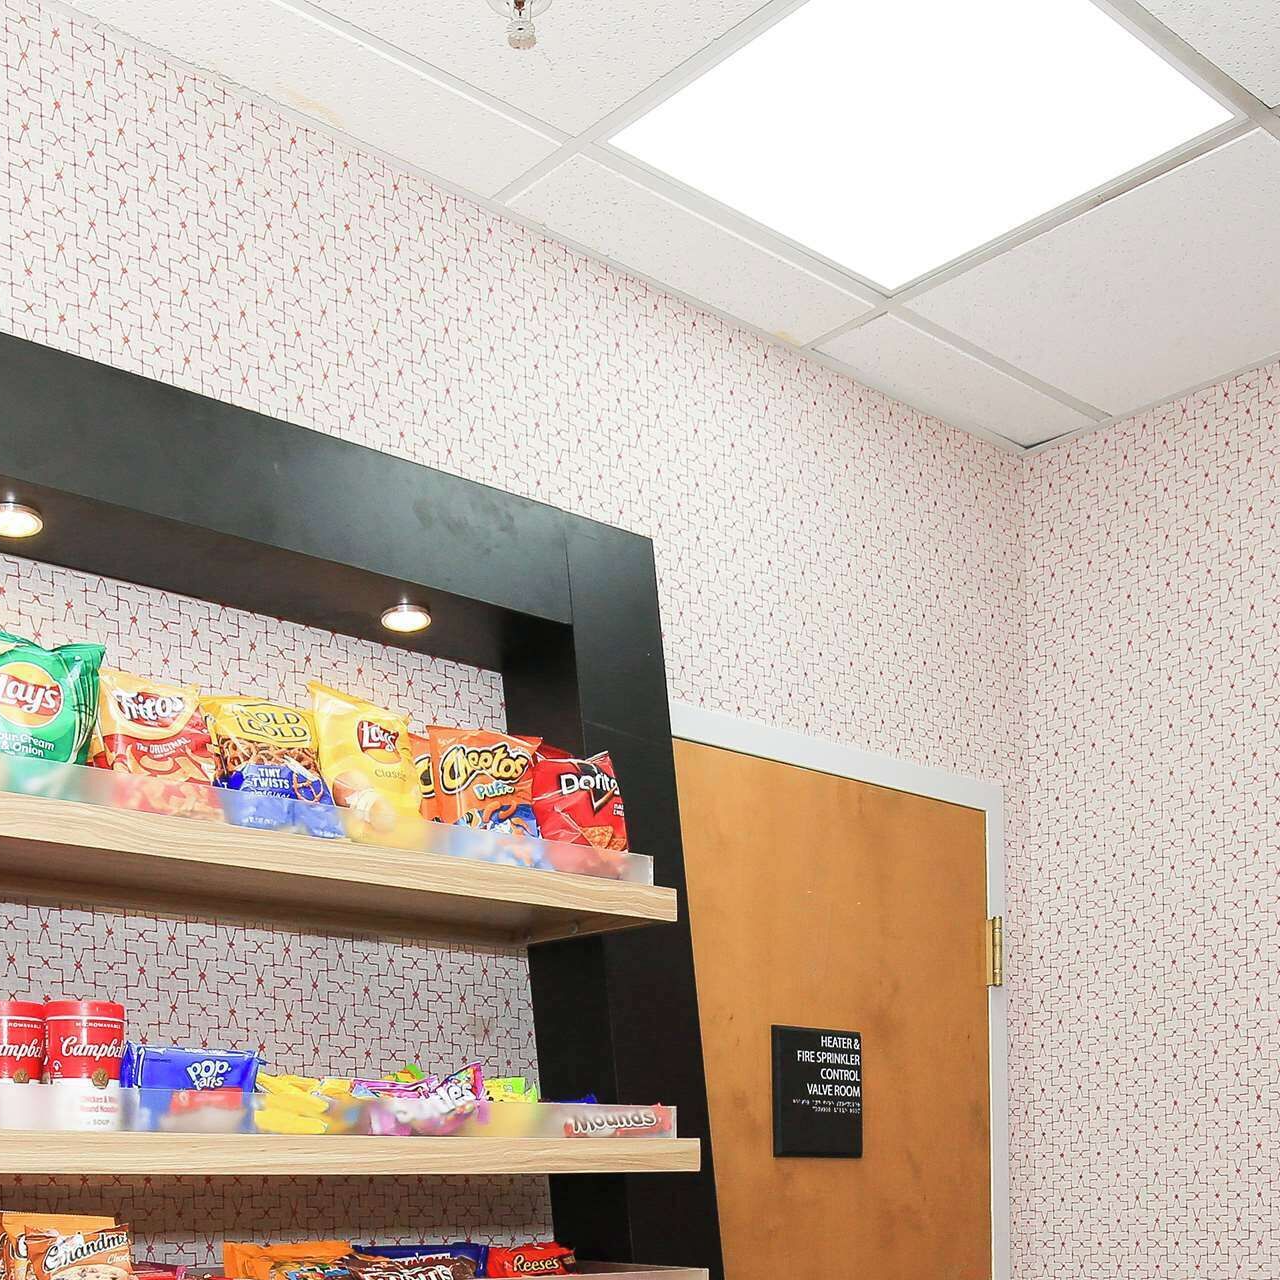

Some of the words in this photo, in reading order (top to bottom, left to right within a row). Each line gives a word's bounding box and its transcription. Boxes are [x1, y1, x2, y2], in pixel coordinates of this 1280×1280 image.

[14, 743, 44, 757] Onion
[258, 768, 280, 777] TINY
[441, 744, 528, 792] Cheetos
[252, 778, 290, 789] TWISTS
[821, 1036, 852, 1049] HEATER
[854, 1039, 860, 1049] &
[797, 1050, 815, 1062] FIRE
[816, 1051, 860, 1066] SPRINKLER
[820, 1068, 860, 1081] CONTROL
[194, 1074, 224, 1090] tarts
[807, 1083, 833, 1095] VALVE
[834, 1086, 860, 1097] ROOM
[571, 1111, 657, 1133] Mounds
[513, 1255, 559, 1272] Reese's
